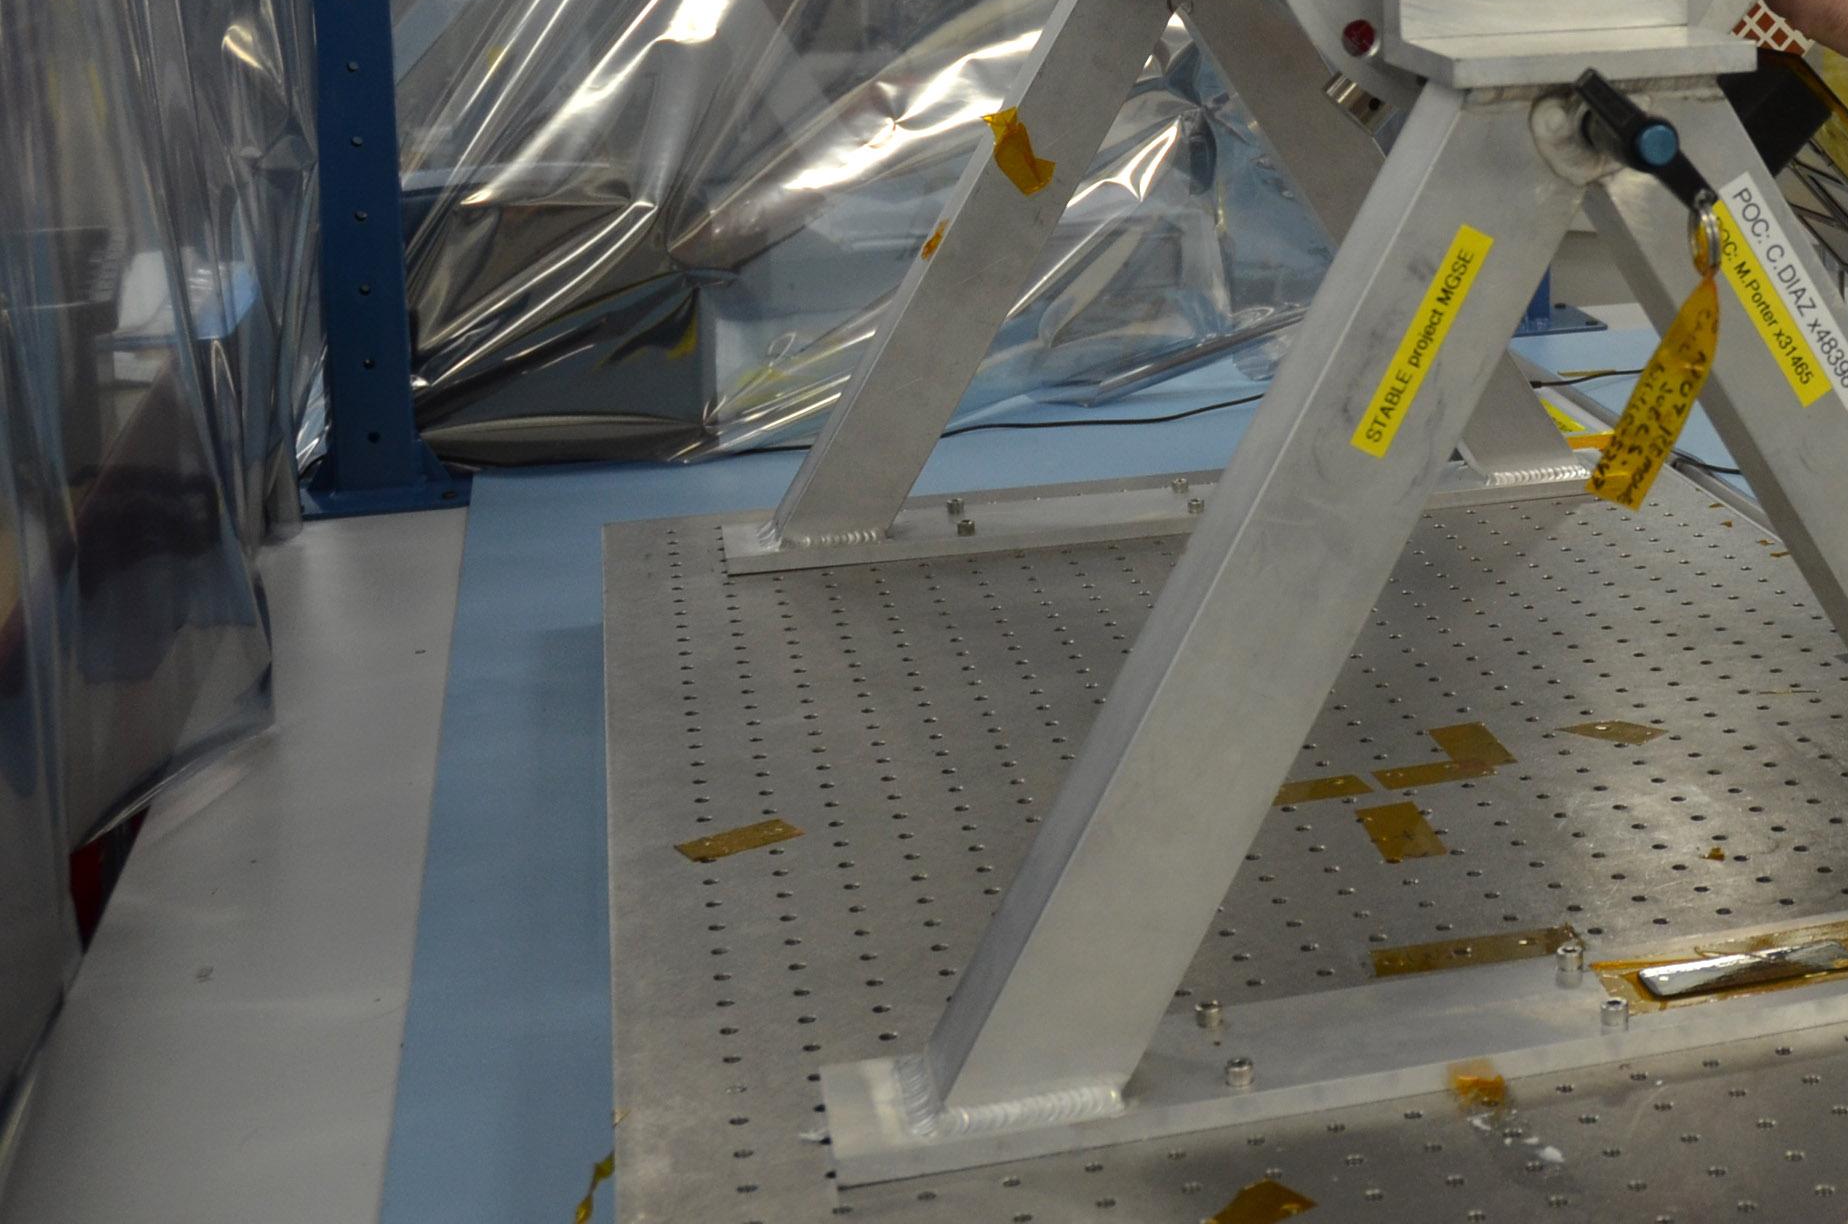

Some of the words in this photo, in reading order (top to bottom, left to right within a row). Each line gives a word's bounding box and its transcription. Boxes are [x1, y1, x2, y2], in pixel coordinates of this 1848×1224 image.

[1732, 188, 1770, 244] POC:
[1766, 244, 1817, 318] C.DIAZ
[1366, 369, 1412, 443] STABLE
[1408, 309, 1443, 368] project
[1437, 248, 1475, 305] MGSE
[1734, 261, 1779, 327] M.Porter
[1774, 330, 1814, 385] x31465
